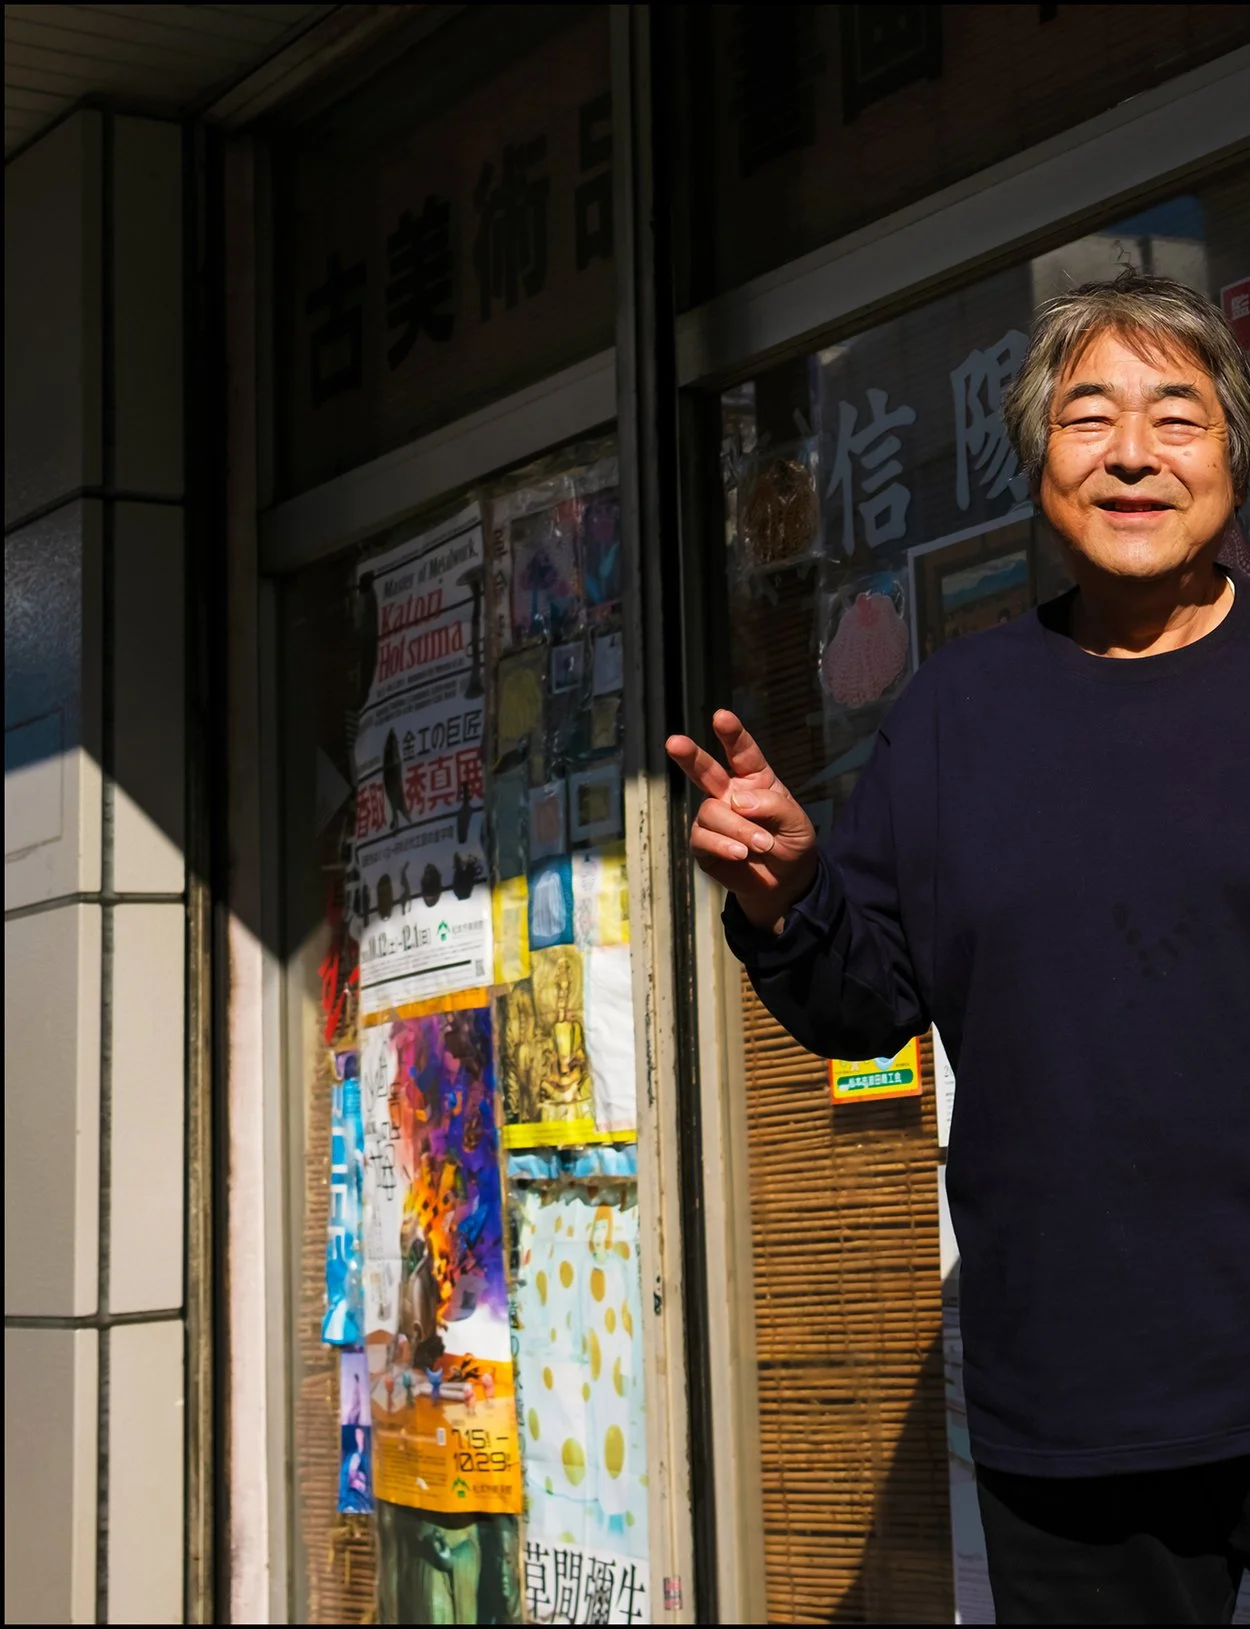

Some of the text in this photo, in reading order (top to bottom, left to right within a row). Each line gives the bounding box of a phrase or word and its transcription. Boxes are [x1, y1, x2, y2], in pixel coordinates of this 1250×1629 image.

[381, 578, 443, 633] Katori
[378, 620, 464, 684] Hotsuma
[402, 709, 483, 760] 金工の巨匠
[524, 1542, 647, 1625] 草間彌生
